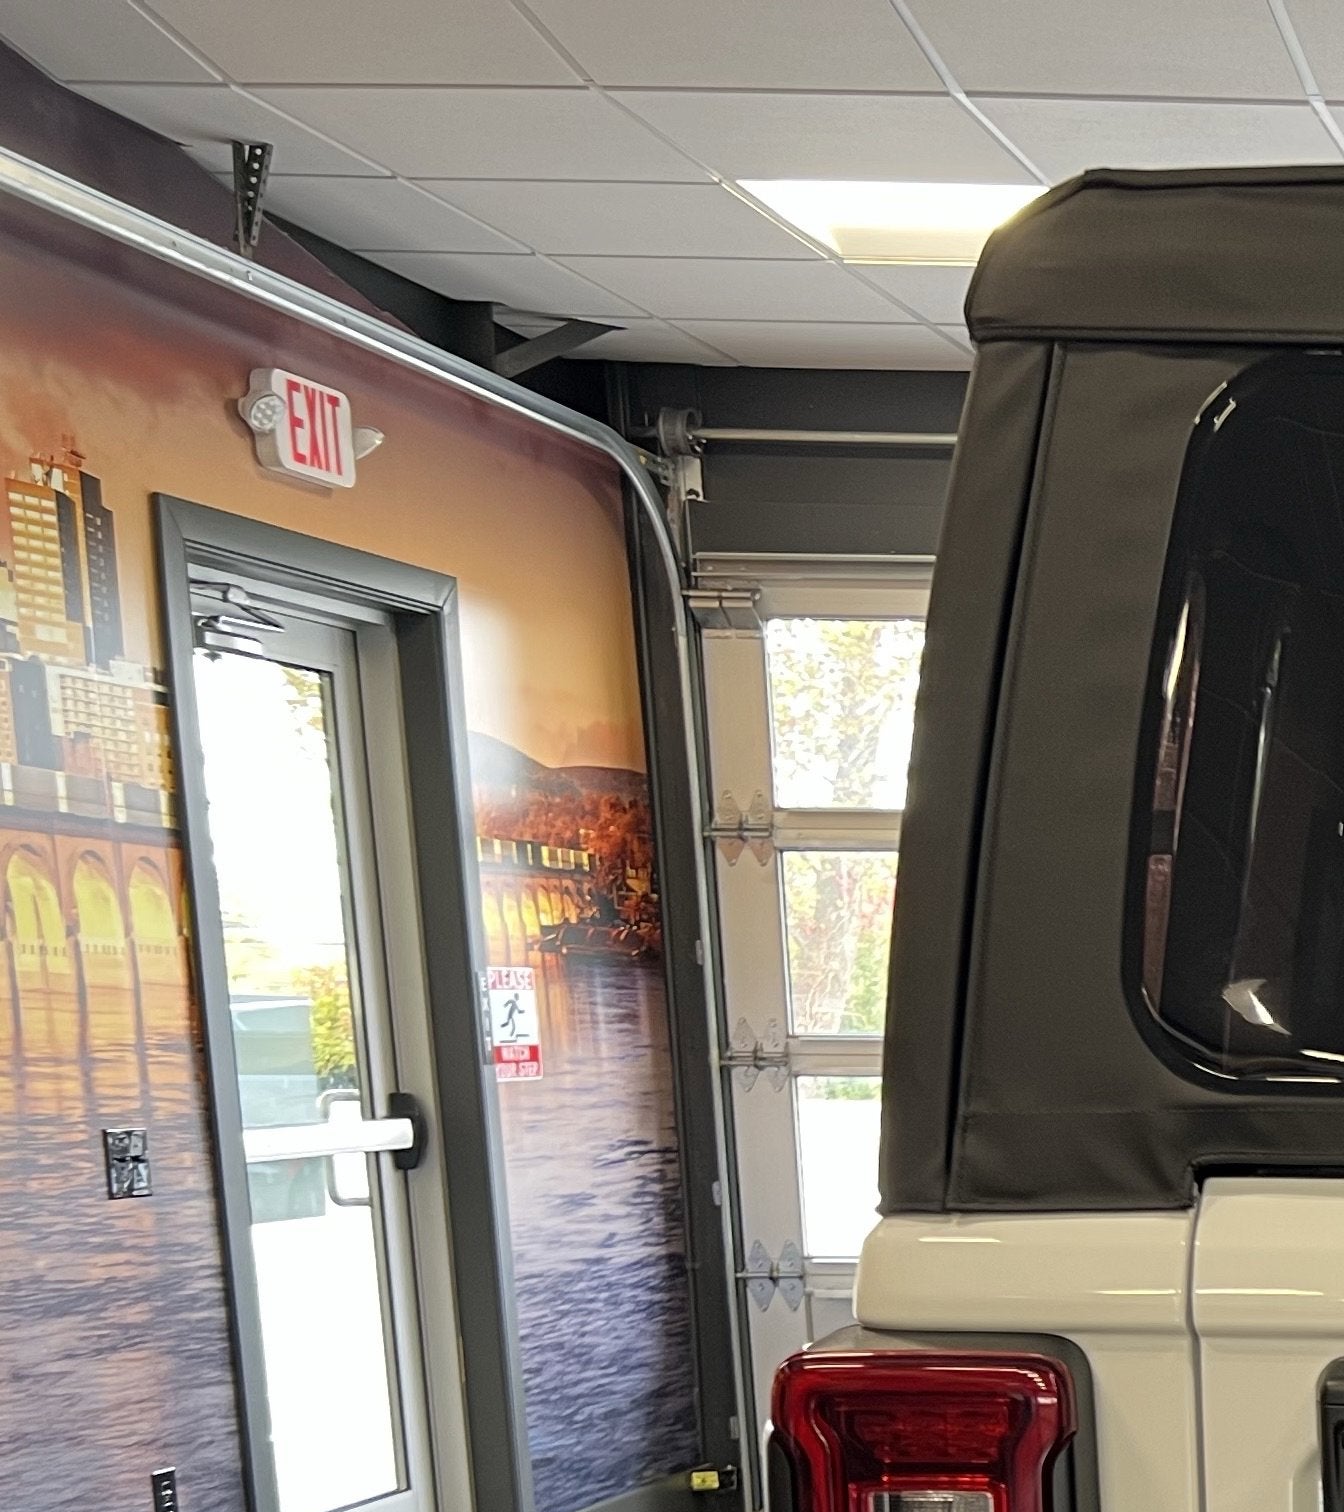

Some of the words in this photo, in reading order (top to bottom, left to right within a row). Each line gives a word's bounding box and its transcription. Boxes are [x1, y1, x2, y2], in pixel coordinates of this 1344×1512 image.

[286, 378, 343, 476] EXIT
[488, 970, 533, 989] PLEASE
[518, 1061, 539, 1076] STEP
